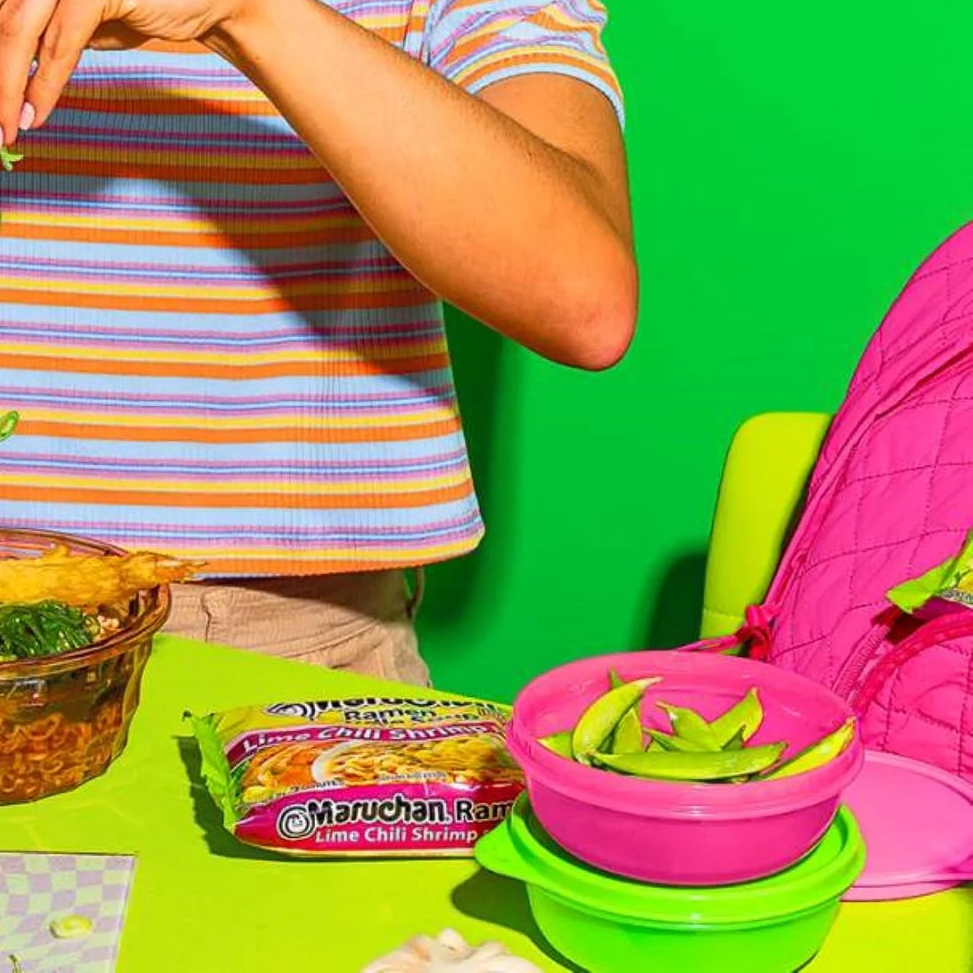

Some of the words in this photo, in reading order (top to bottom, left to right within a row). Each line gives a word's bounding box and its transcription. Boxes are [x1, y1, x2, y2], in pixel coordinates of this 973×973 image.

[344, 707, 438, 723] Ramen
[243, 732, 313, 753] Lime
[317, 727, 381, 742] Chili
[389, 725, 488, 741] Shrimp
[307, 793, 446, 827] Maruchan
[315, 828, 360, 845] Lime
[364, 827, 407, 843] Chili
[410, 827, 478, 845] Shrimp
